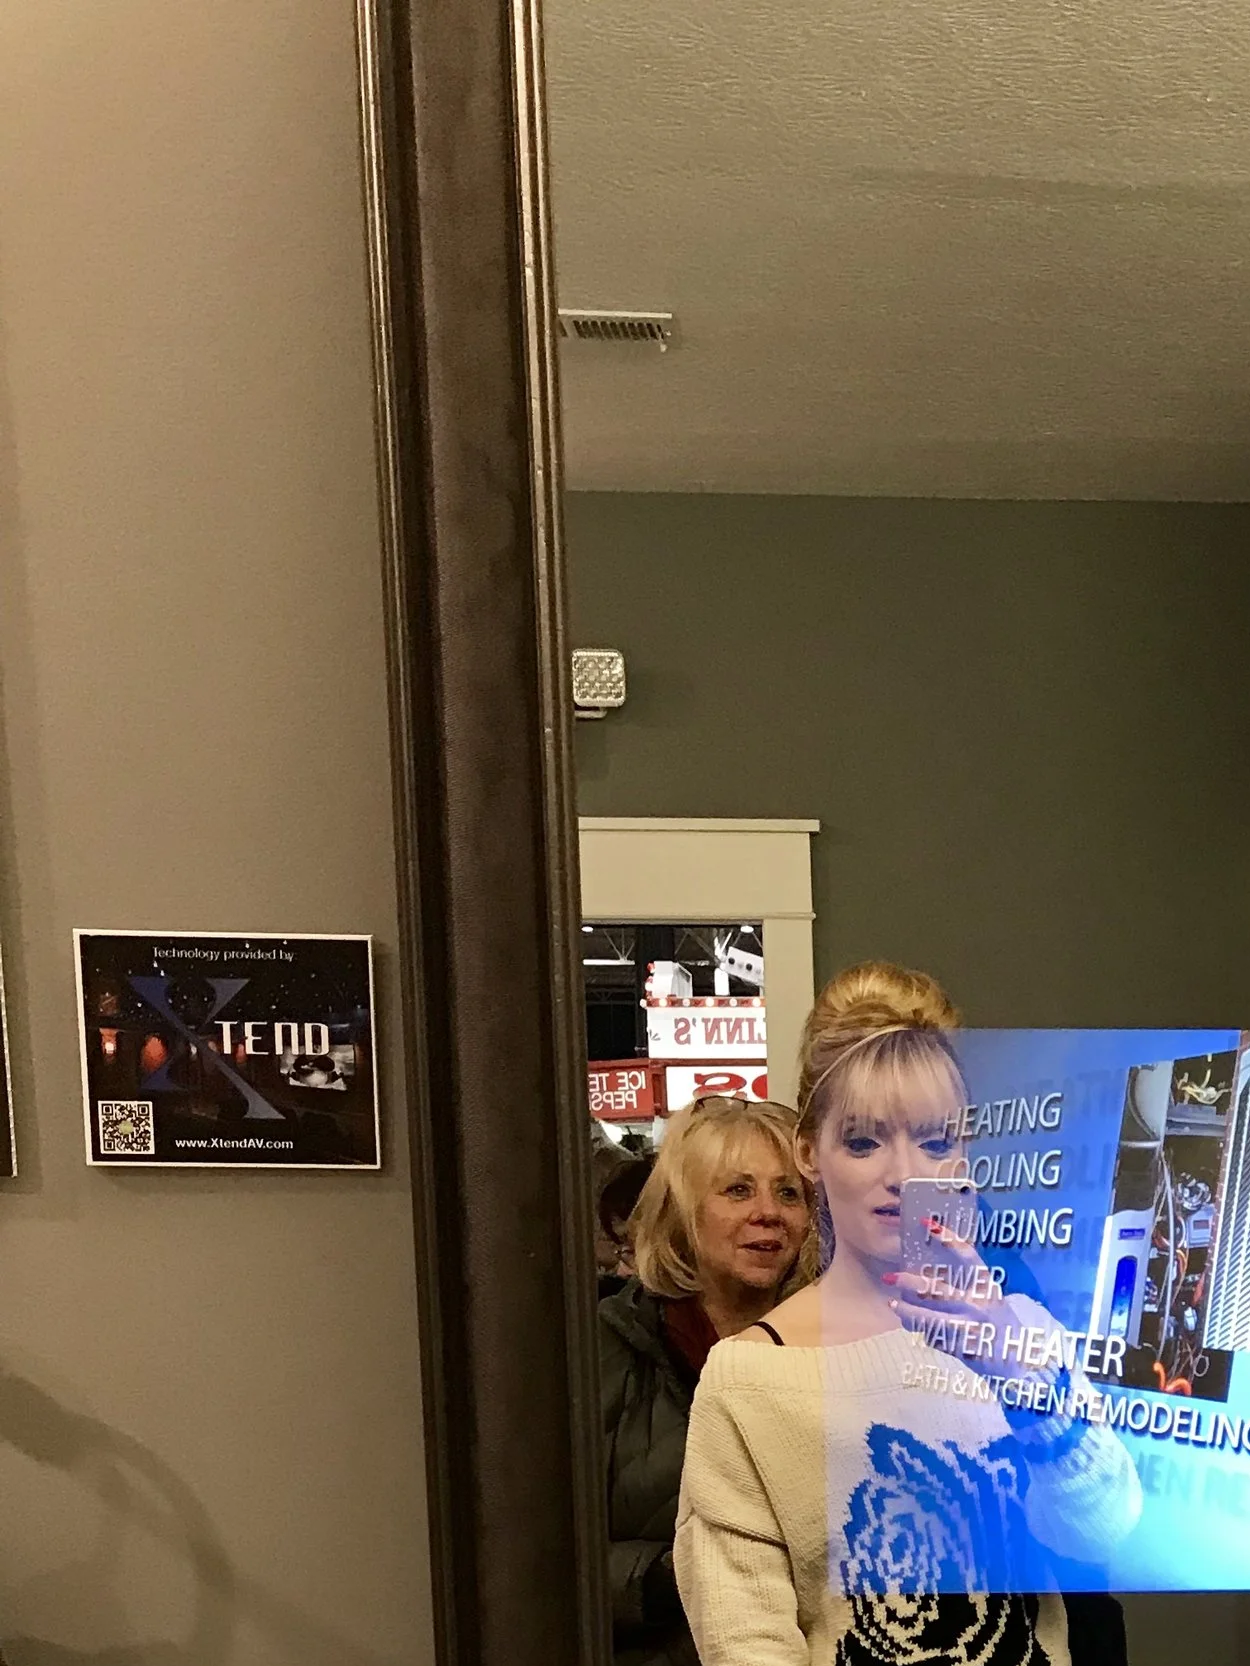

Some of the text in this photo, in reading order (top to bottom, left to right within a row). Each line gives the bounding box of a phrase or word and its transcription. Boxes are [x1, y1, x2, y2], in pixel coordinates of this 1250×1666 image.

[153, 946, 220, 961] Technology
[224, 949, 276, 961] provided
[943, 1092, 1062, 1138] HEATING
[175, 1137, 294, 1149] www.XtendAV.com
[935, 1150, 1062, 1190] COOLING
[927, 1207, 1073, 1246] PLUMBING
[917, 1263, 1006, 1300] SEWER
[909, 1316, 1127, 1377] WATER HEATER
[902, 1361, 948, 1391] BATH
[953, 1371, 968, 1396] &
[971, 1373, 1066, 1415] KITCHEN
